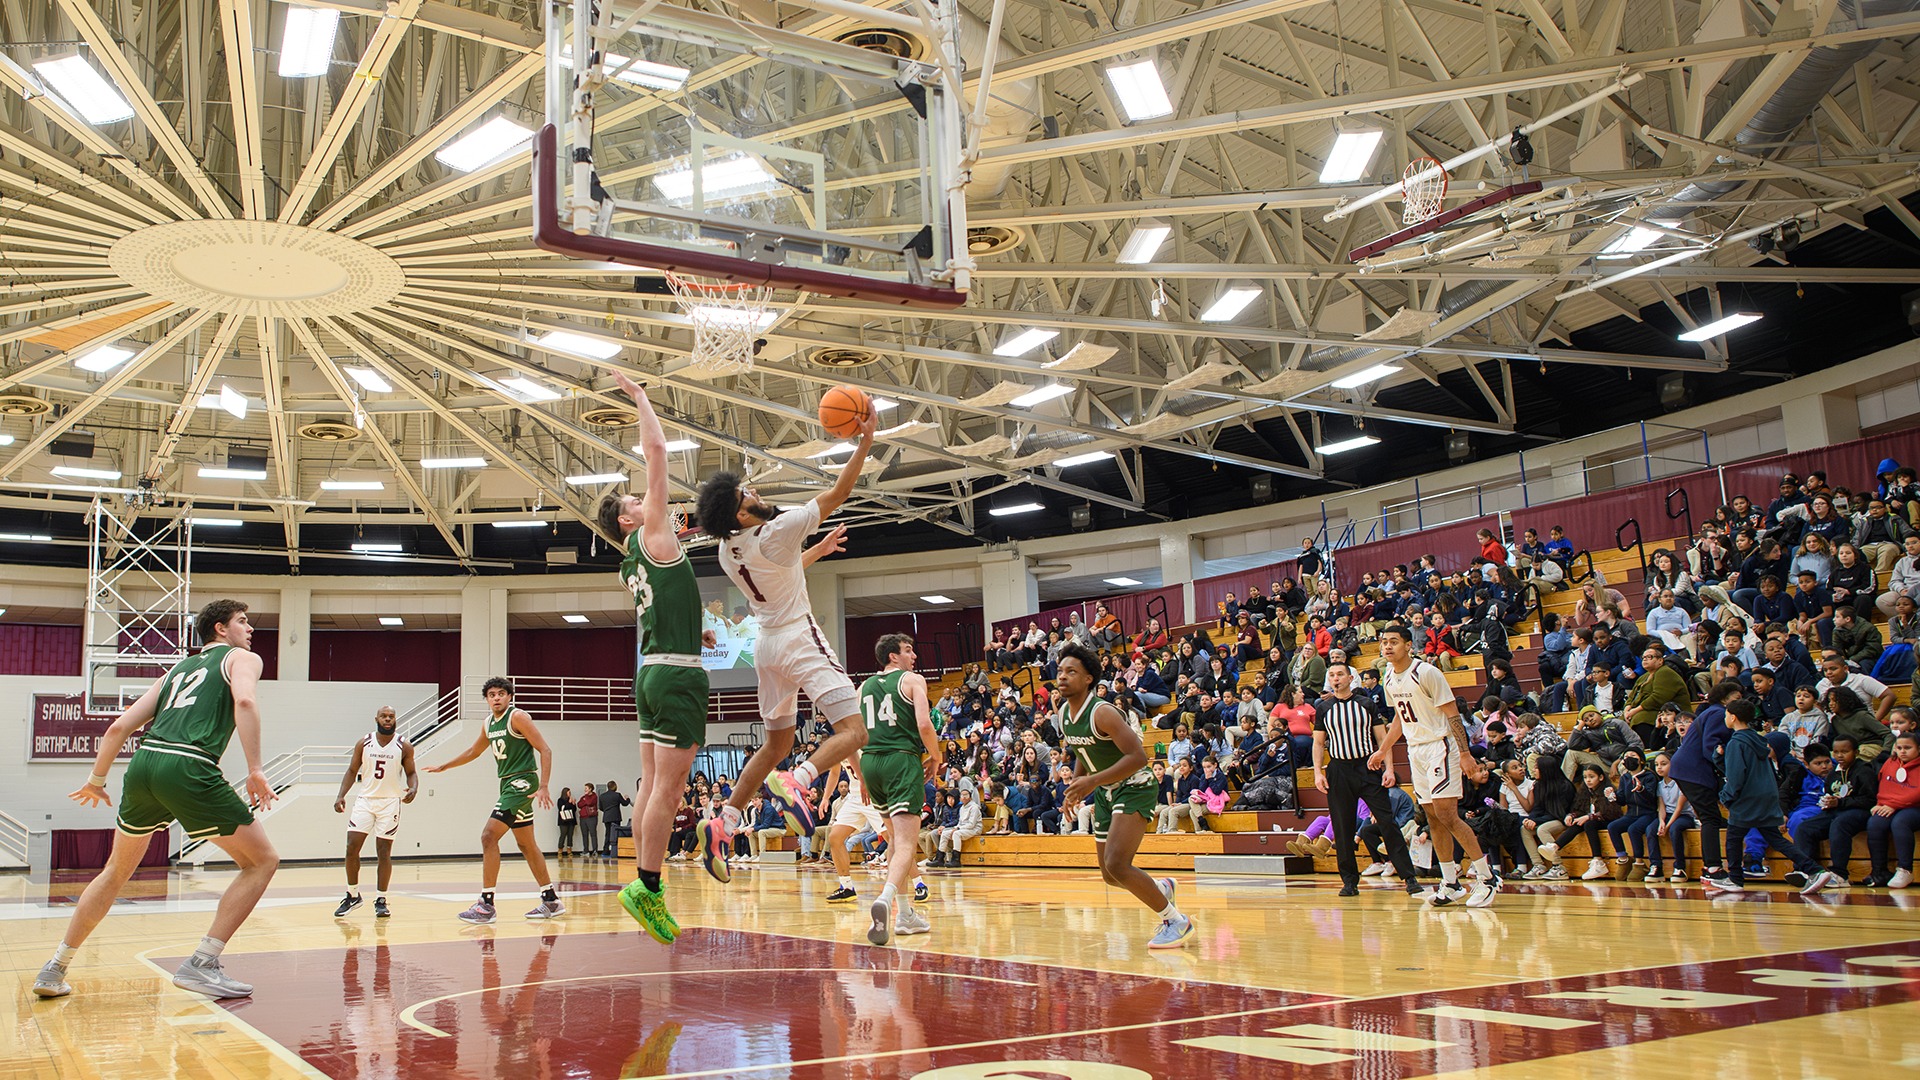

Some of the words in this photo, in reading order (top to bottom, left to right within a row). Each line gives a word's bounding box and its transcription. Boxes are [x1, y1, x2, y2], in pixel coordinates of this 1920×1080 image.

[738, 564, 767, 602] 1
[163, 667, 208, 711] 12
[863, 693, 898, 730] 14
[1398, 701, 1419, 723] 21
[35, 736, 90, 753] BIRTHPLACE
[374, 760, 386, 780] 5
[1077, 747, 1097, 773] 1
